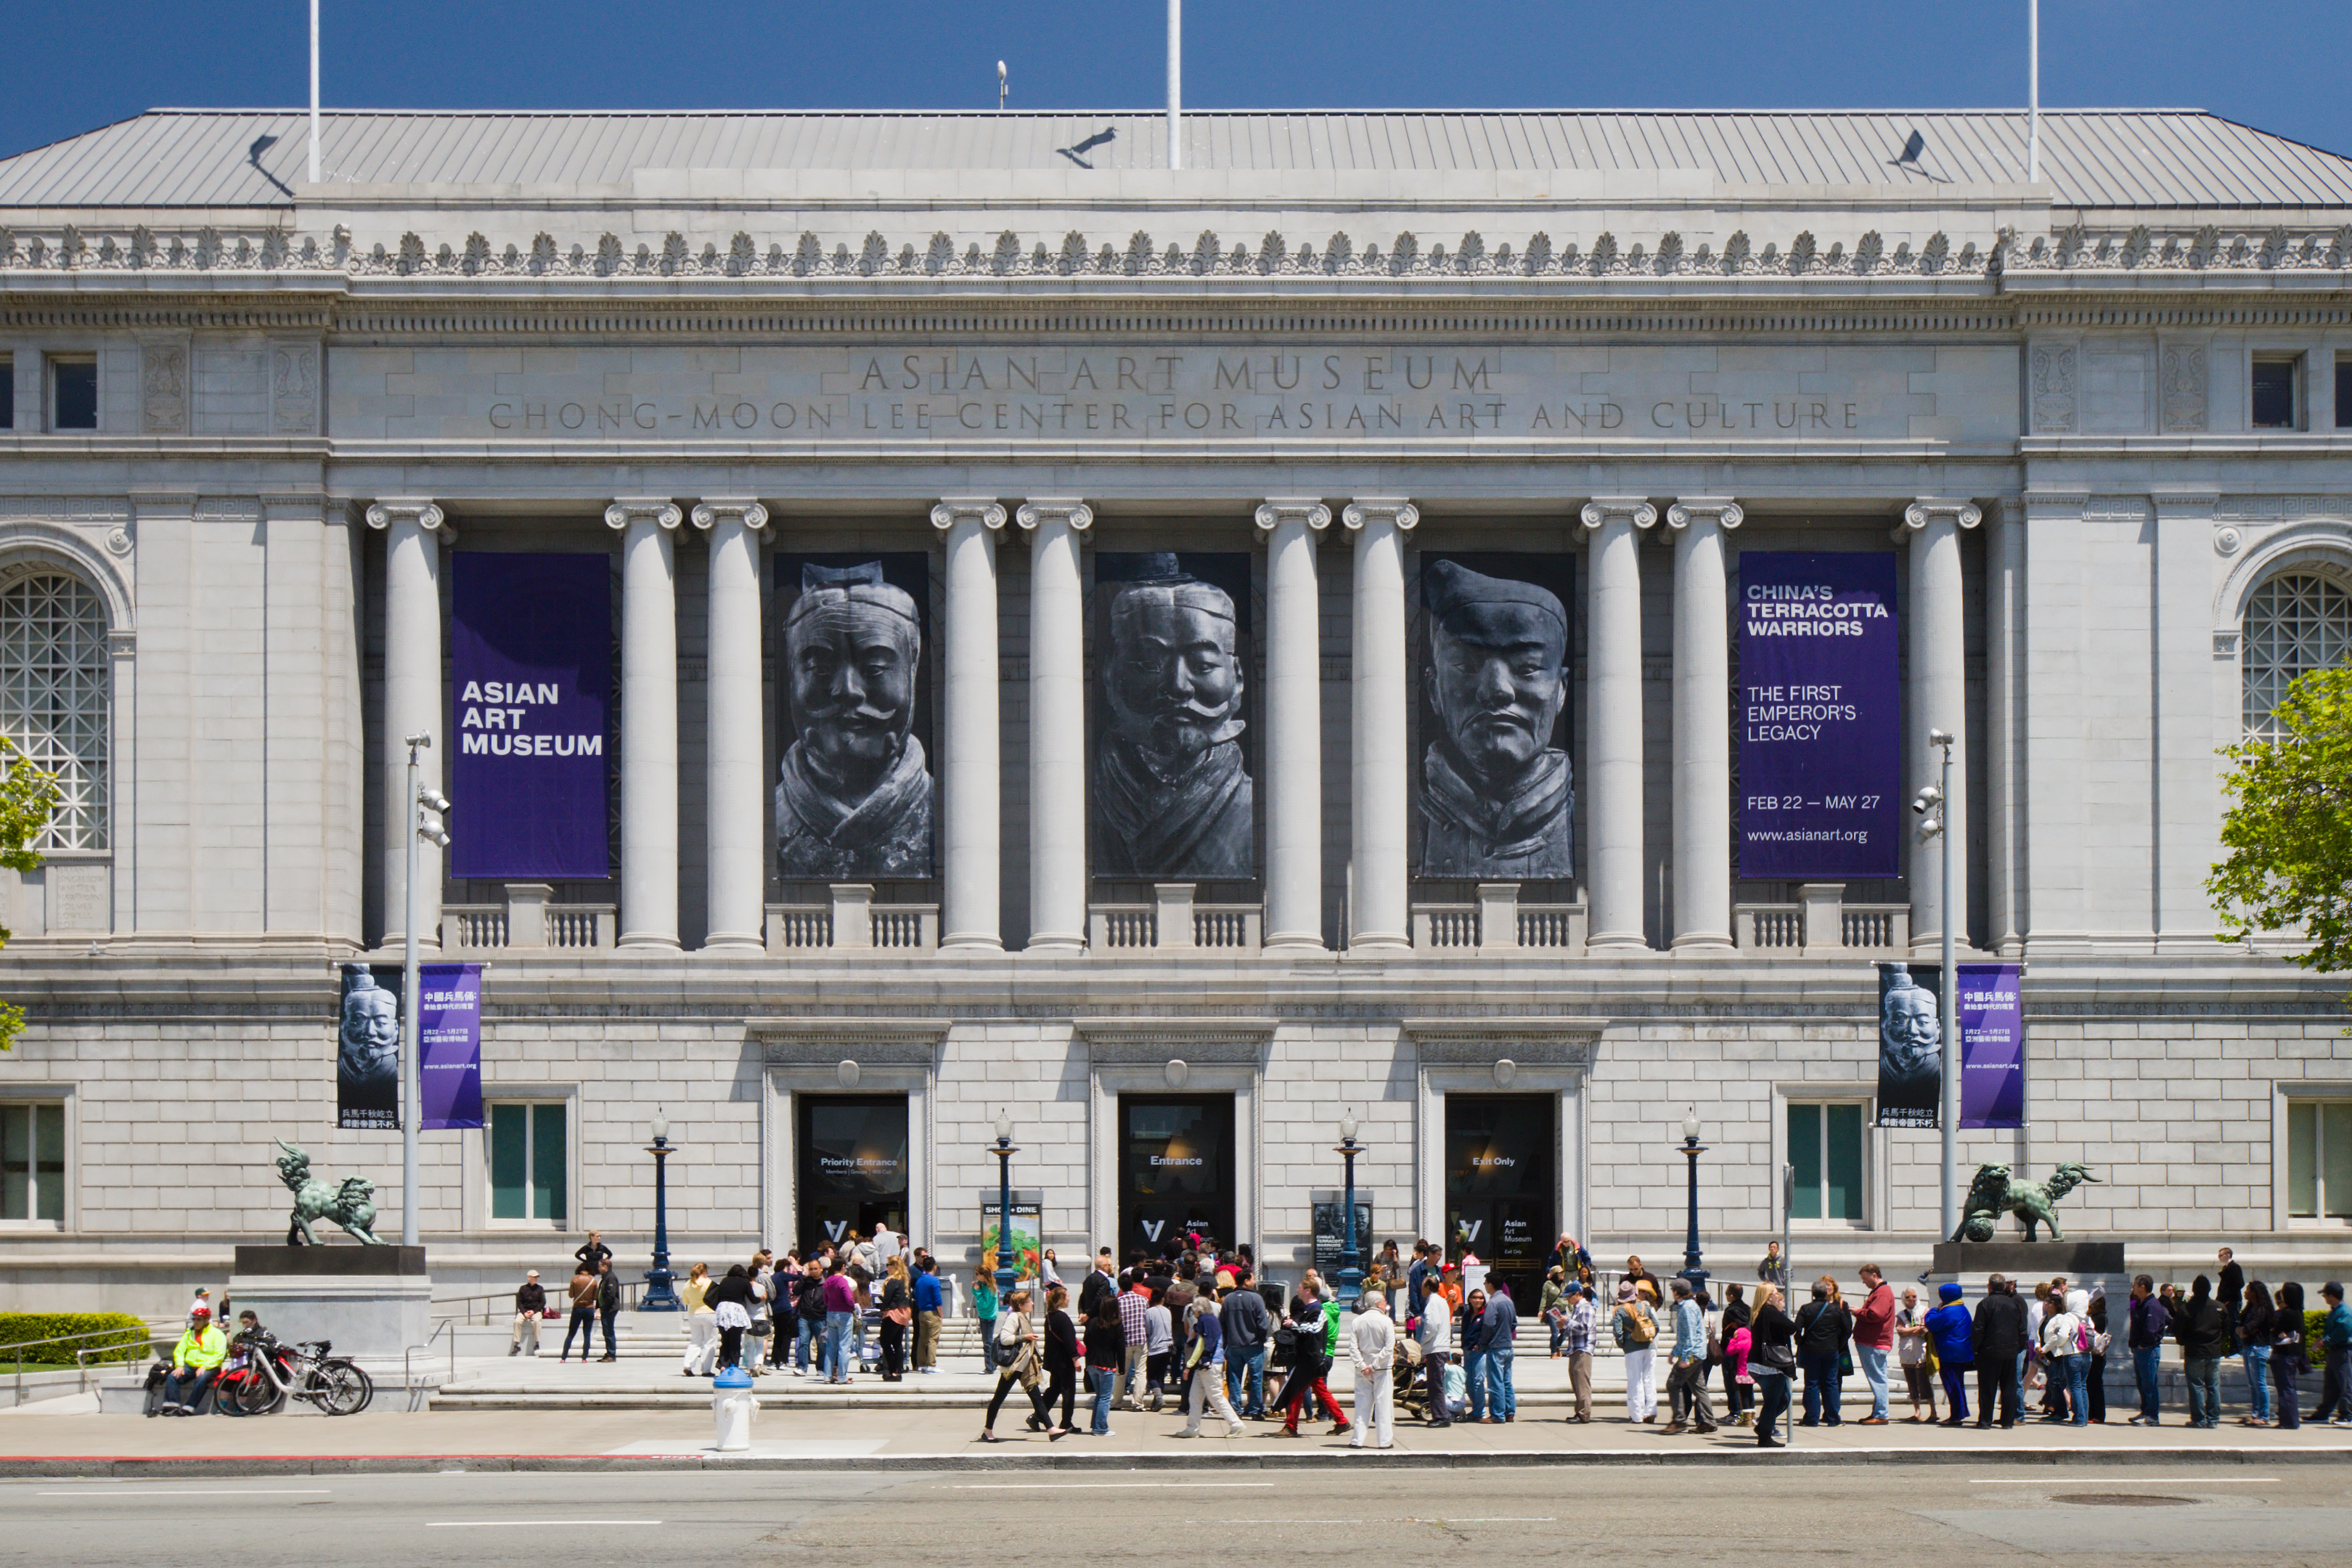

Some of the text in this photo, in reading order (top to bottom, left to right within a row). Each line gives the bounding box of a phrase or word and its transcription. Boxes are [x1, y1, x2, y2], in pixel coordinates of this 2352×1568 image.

[859, 356, 1492, 391] ASIAN ART MUSEUM
[489, 402, 1859, 430] CHONG-MOON LEE CENTER FOR ASIAN ART AND CULTURE
[1747, 584, 1834, 601] CHINA'S
[1747, 603, 1889, 618] TERRACOTTA
[1747, 621, 1864, 637] WARRIORS
[461, 680, 559, 705] ASIAN
[1747, 685, 1842, 702] THE FIRST
[461, 706, 526, 730] ART
[1747, 705, 1857, 722] EMPEROR'S
[1747, 724, 1821, 742] LEGACY
[462, 732, 603, 756] MUSEUM
[1747, 796, 1779, 810] FEB
[1782, 796, 1802, 809] 22
[1825, 795, 1857, 809] MAY
[1861, 795, 1881, 809] 27
[1747, 827, 1868, 844] www.asianart.org
[821, 1158, 898, 1167] Priority Entrance
[1150, 1156, 1203, 1166] Entrance
[1473, 1157, 1516, 1167] Exit Only
